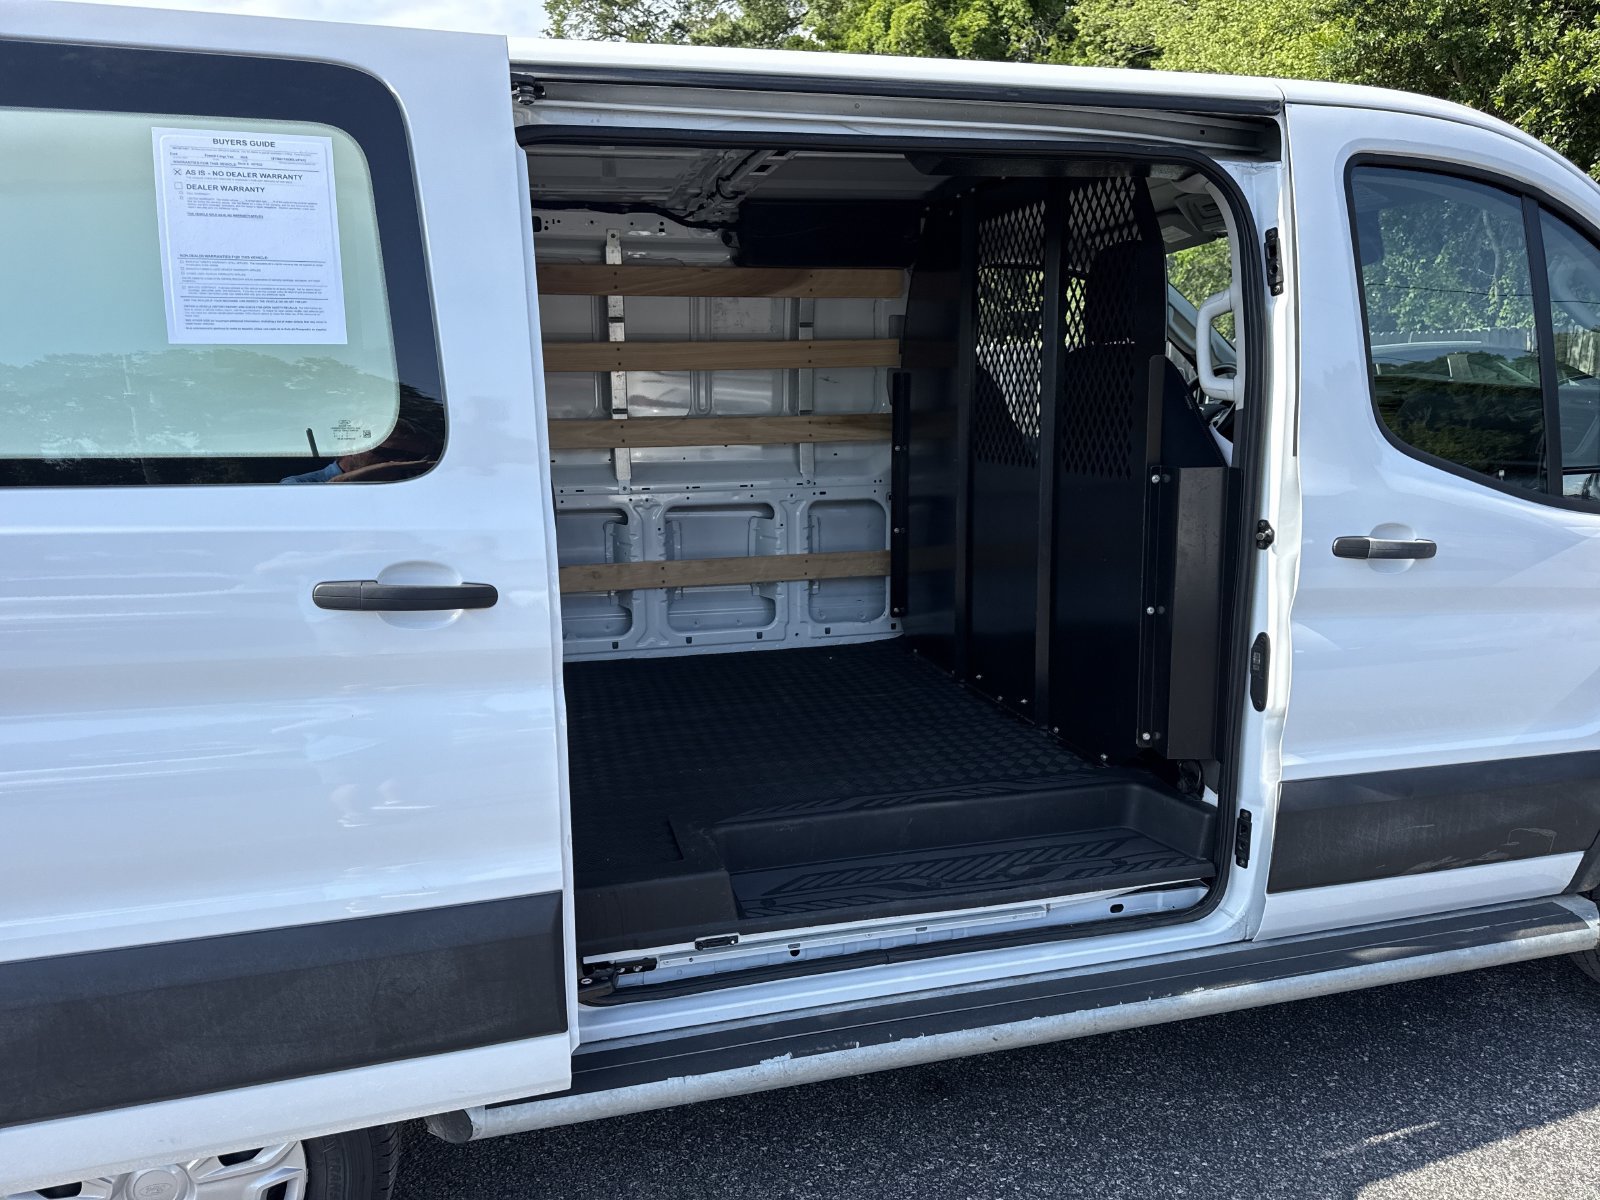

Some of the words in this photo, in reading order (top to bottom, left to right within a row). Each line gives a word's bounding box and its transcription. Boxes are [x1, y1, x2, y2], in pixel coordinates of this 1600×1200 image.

[212, 138, 248, 147] BUYERS
[249, 140, 276, 148] GUIDE
[226, 171, 258, 179] DEALER
[259, 172, 303, 181] WARRANTY
[186, 183, 219, 191] DEALER
[220, 184, 265, 193] WARRANTY
